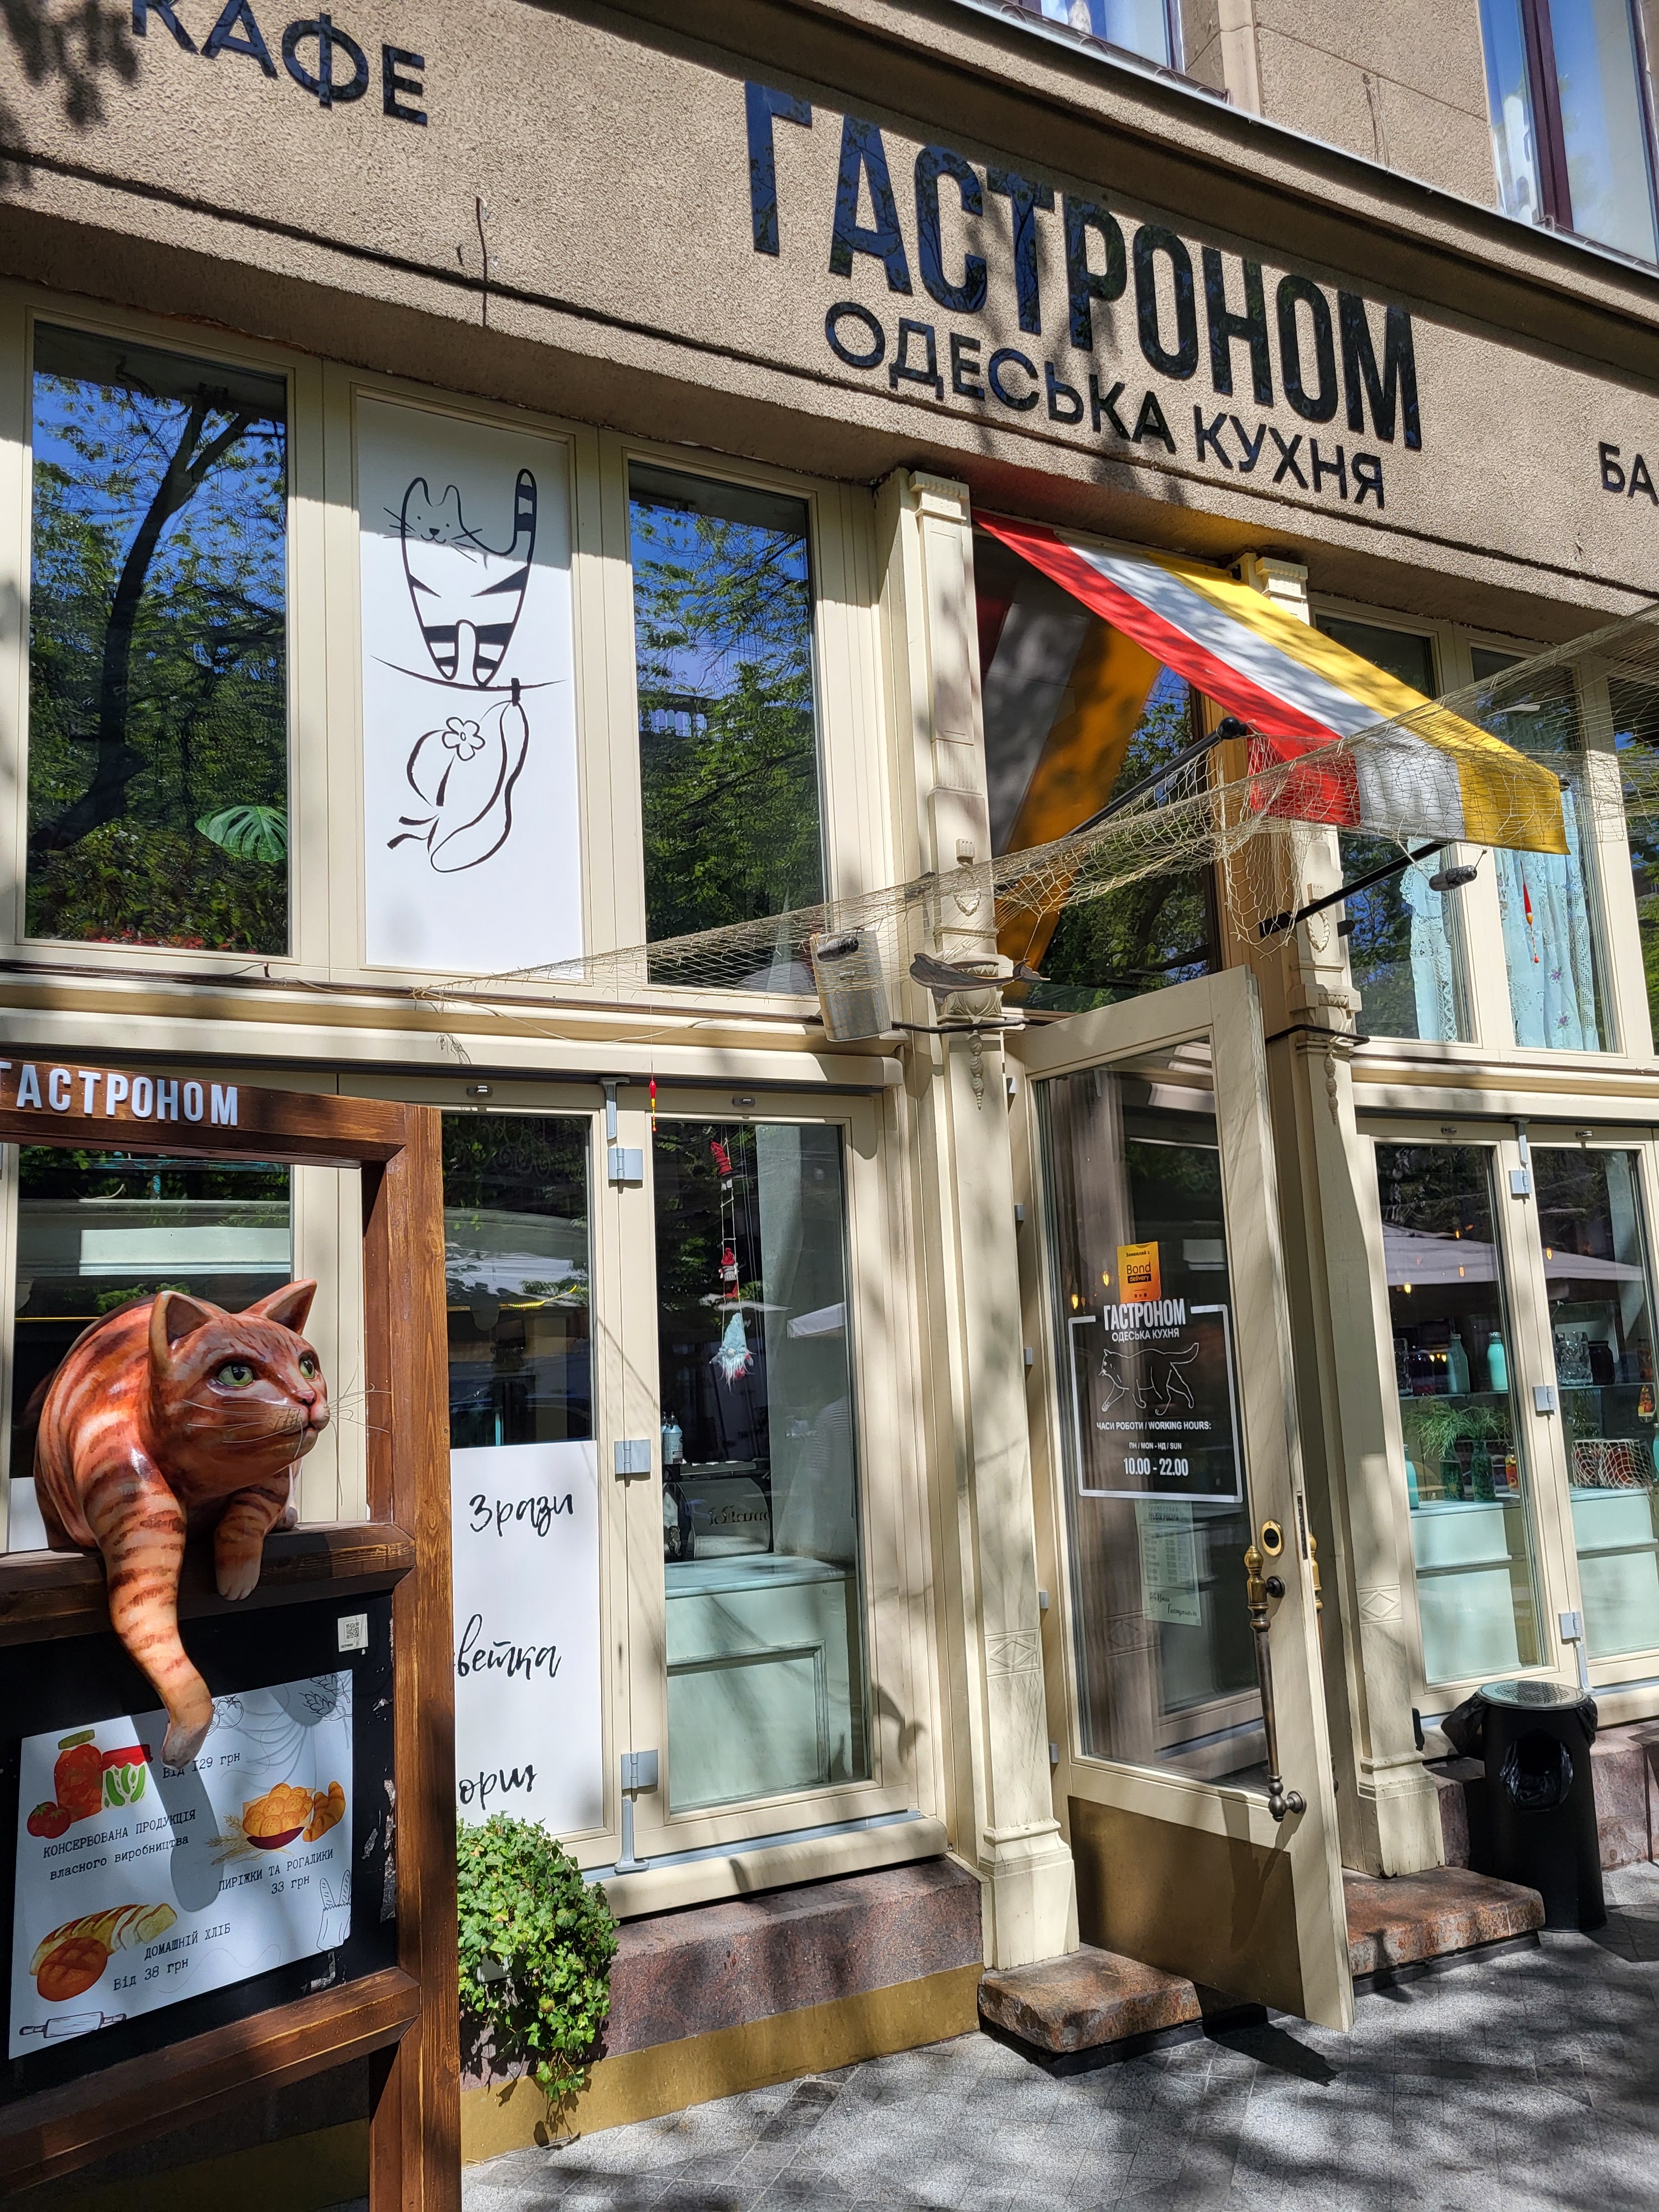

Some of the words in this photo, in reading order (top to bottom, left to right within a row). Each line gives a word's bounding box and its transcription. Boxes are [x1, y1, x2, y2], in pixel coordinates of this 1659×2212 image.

[745, 80, 1421, 451] ГАСТРОНОМ
[825, 301, 1176, 454] ОДЕСЬКА
[1193, 405, 1385, 509] КУХНЯ
[1598, 441, 1659, 507] БА
[1126, 1261, 1151, 1275] Bond
[1103, 1298, 1186, 1331] ГАСТРОНОМ
[1112, 1330, 1151, 1343] ОДЕСЬКА
[1152, 1328, 1180, 1340] КУХНЯ
[1096, 1422, 1115, 1431] ЧАСИ
[1116, 1422, 1144, 1431] РОБОТИ
[1148, 1421, 1182, 1431] WORKING
[1183, 1421, 1212, 1431] HOURS:
[1157, 1442, 1166, 1451] НД
[1124, 1458, 1150, 1475] 10.00
[1159, 1458, 1188, 1476] 22.00
[469, 1493, 574, 1537] Зрази
[453, 1614, 562, 1680] ветка
[220, 1752, 240, 1766] грн
[43, 1827, 129, 1858] КОНСЕРВОВАНА
[135, 1809, 196, 1834] ПРОДУКЦІЯ
[50, 1858, 107, 1880] власного
[114, 1836, 189, 1863] виробництва
[218, 1869, 263, 1891] ПИРІЖКИ
[269, 1865, 280, 1876] ТА
[286, 1849, 333, 1871] РОГАЛИКИ
[271, 1881, 284, 1895] 33
[291, 1875, 310, 1889] грн
[144, 1930, 198, 1961] ДОМАШНІЙ
[204, 1923, 231, 1940] ХЛІБ
[113, 1976, 137, 1991] Від
[144, 1965, 159, 1980] 38
[167, 1958, 189, 1974] грн
